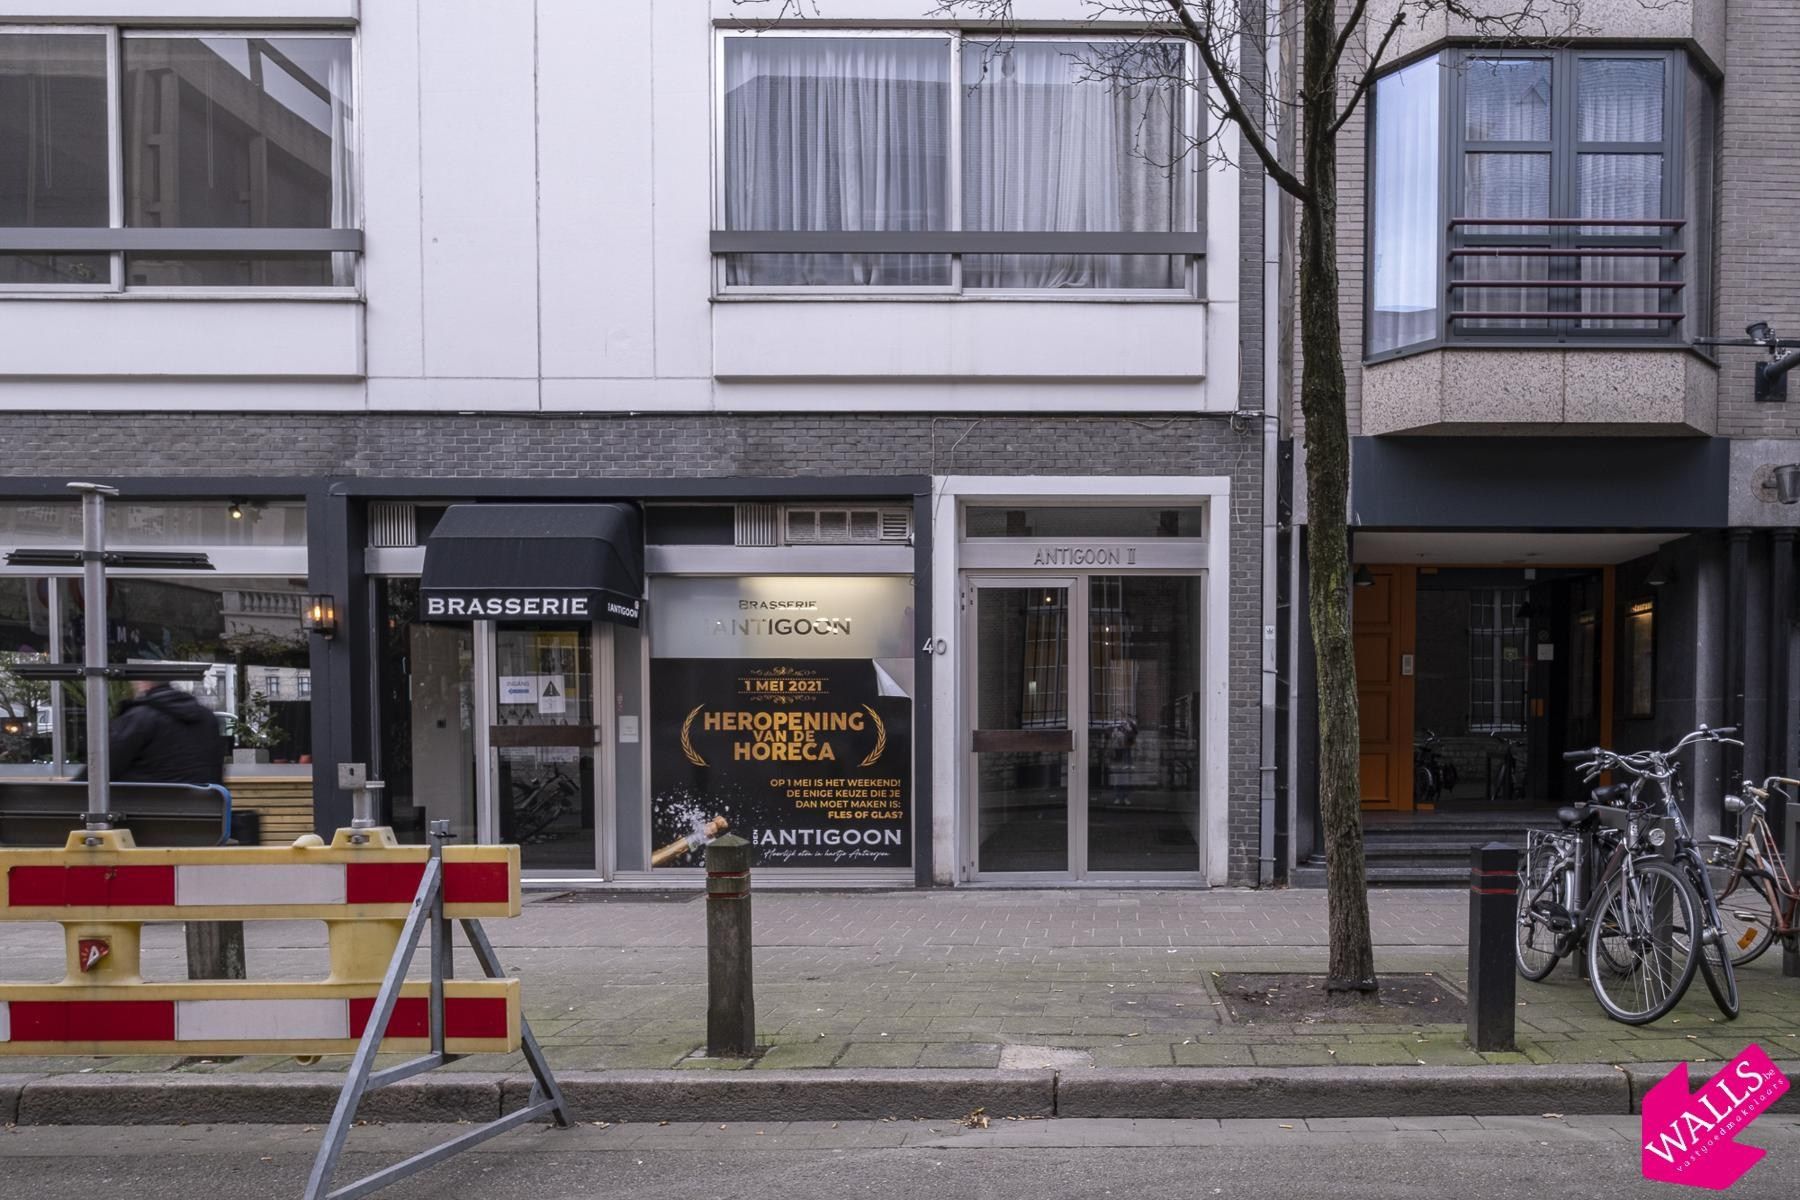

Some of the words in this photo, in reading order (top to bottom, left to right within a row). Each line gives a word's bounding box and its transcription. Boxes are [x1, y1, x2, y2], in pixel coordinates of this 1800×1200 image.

[1034, 548, 1120, 565] ANTIGOON
[428, 598, 588, 615] BRASSERIE
[739, 600, 817, 610] BRASSERIE
[713, 618, 852, 636] ANTIGOON
[922, 637, 947, 655] 40
[744, 680, 750, 691] 1
[756, 680, 784, 691] MEI
[788, 680, 822, 691] 2021
[703, 712, 865, 731] HEROPENING
[753, 731, 787, 742] VAN
[794, 731, 815, 742] DE
[734, 742, 836, 761] HORECA
[770, 779, 785, 787] OP
[787, 779, 791, 787] 1
[794, 779, 812, 787] MEI
[814, 779, 823, 787] IS
[825, 779, 845, 787] HET
[847, 779, 901, 787] WEEKEND!
[786, 789, 800, 797] DE
[803, 789, 833, 797] ENIGE
[836, 789, 868, 797] KEUZE
[870, 789, 887, 797] DIE
[889, 789, 901, 797] JE
[795, 800, 817, 808] DAN
[820, 800, 848, 808] MOET
[851, 800, 887, 808] MAKEN
[889, 800, 901, 808] IS:
[828, 811, 851, 819] FLES
[854, 811, 869, 819] OF
[870, 811, 903, 819] GLAS?
[760, 829, 902, 845] ANTIGOON
